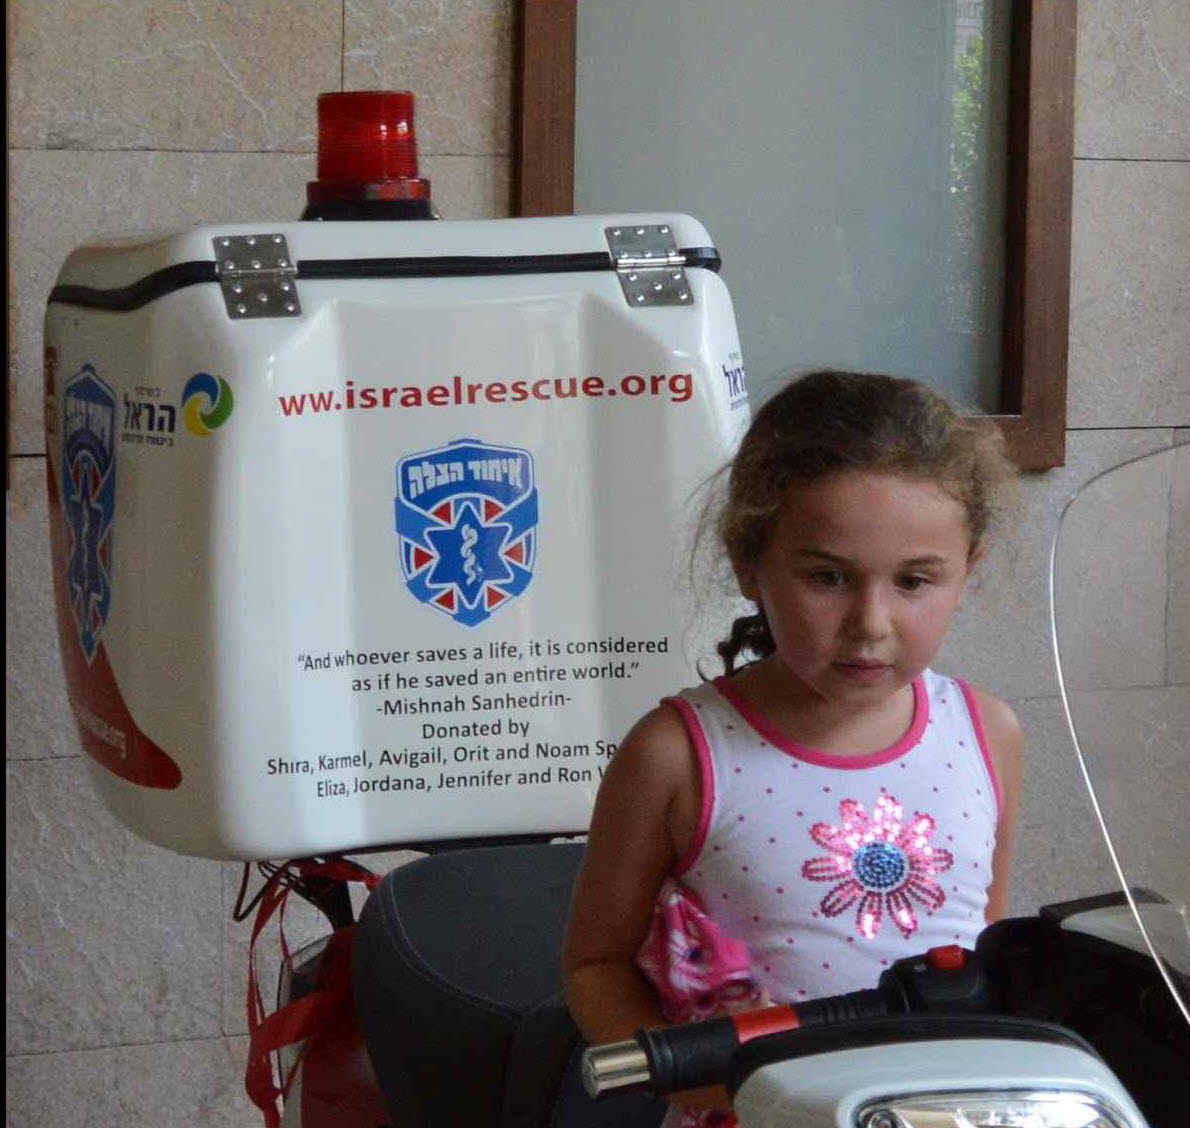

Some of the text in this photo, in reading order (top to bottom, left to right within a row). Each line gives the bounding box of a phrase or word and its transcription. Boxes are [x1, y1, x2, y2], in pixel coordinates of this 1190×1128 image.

[278, 373, 692, 417] ww.israelrescue.org
[722, 364, 747, 397] ראל
[123, 392, 175, 433] הראל
[408, 455, 524, 500] איחוד הצלה
[334, 650, 411, 668] whoever
[416, 647, 467, 663] saves
[473, 648, 483, 660] a
[489, 642, 523, 660] life,
[529, 640, 541, 656] it
[547, 640, 561, 656] is
[566, 637, 668, 655] considered
[352, 679, 371, 692] as
[377, 673, 391, 690] if
[396, 673, 419, 689] he
[425, 669, 478, 687] saved
[485, 672, 506, 685] an
[513, 665, 567, 682] entire
[376, 691, 571, 715] -Mishnah Sanhedrin-
[422, 718, 530, 739] Donated by
[267, 740, 618, 775] Shira, Karmel, Avigail, Orit and Noam Sp
[317, 780, 350, 798] Eliza,
[353, 775, 432, 793] Jordana,
[437, 770, 512, 789] Jennifer
[517, 767, 551, 785] and
[558, 767, 592, 782] Ron
